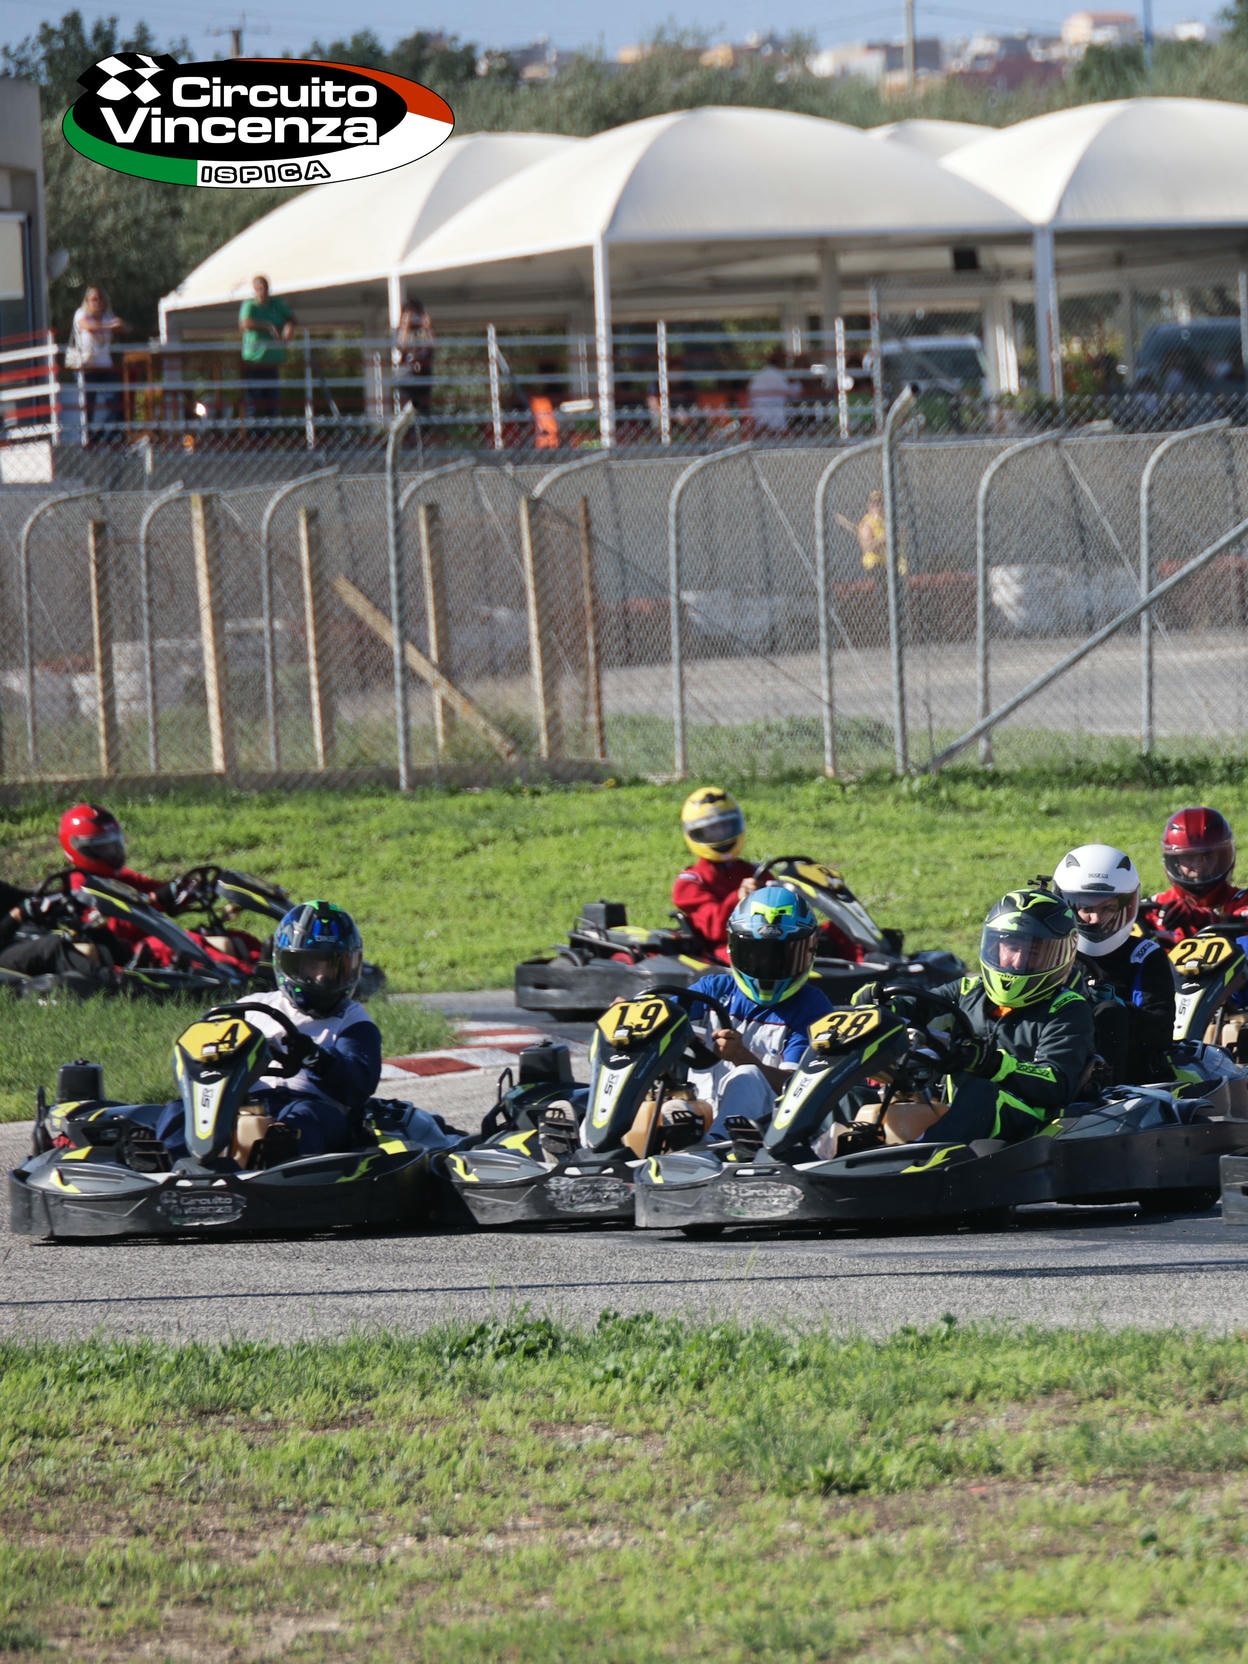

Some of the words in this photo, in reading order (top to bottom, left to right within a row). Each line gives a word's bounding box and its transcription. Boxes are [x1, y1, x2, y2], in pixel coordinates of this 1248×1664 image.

[1175, 941, 1224, 966] 20
[615, 1003, 663, 1033] 19
[216, 1022, 240, 1050] 4
